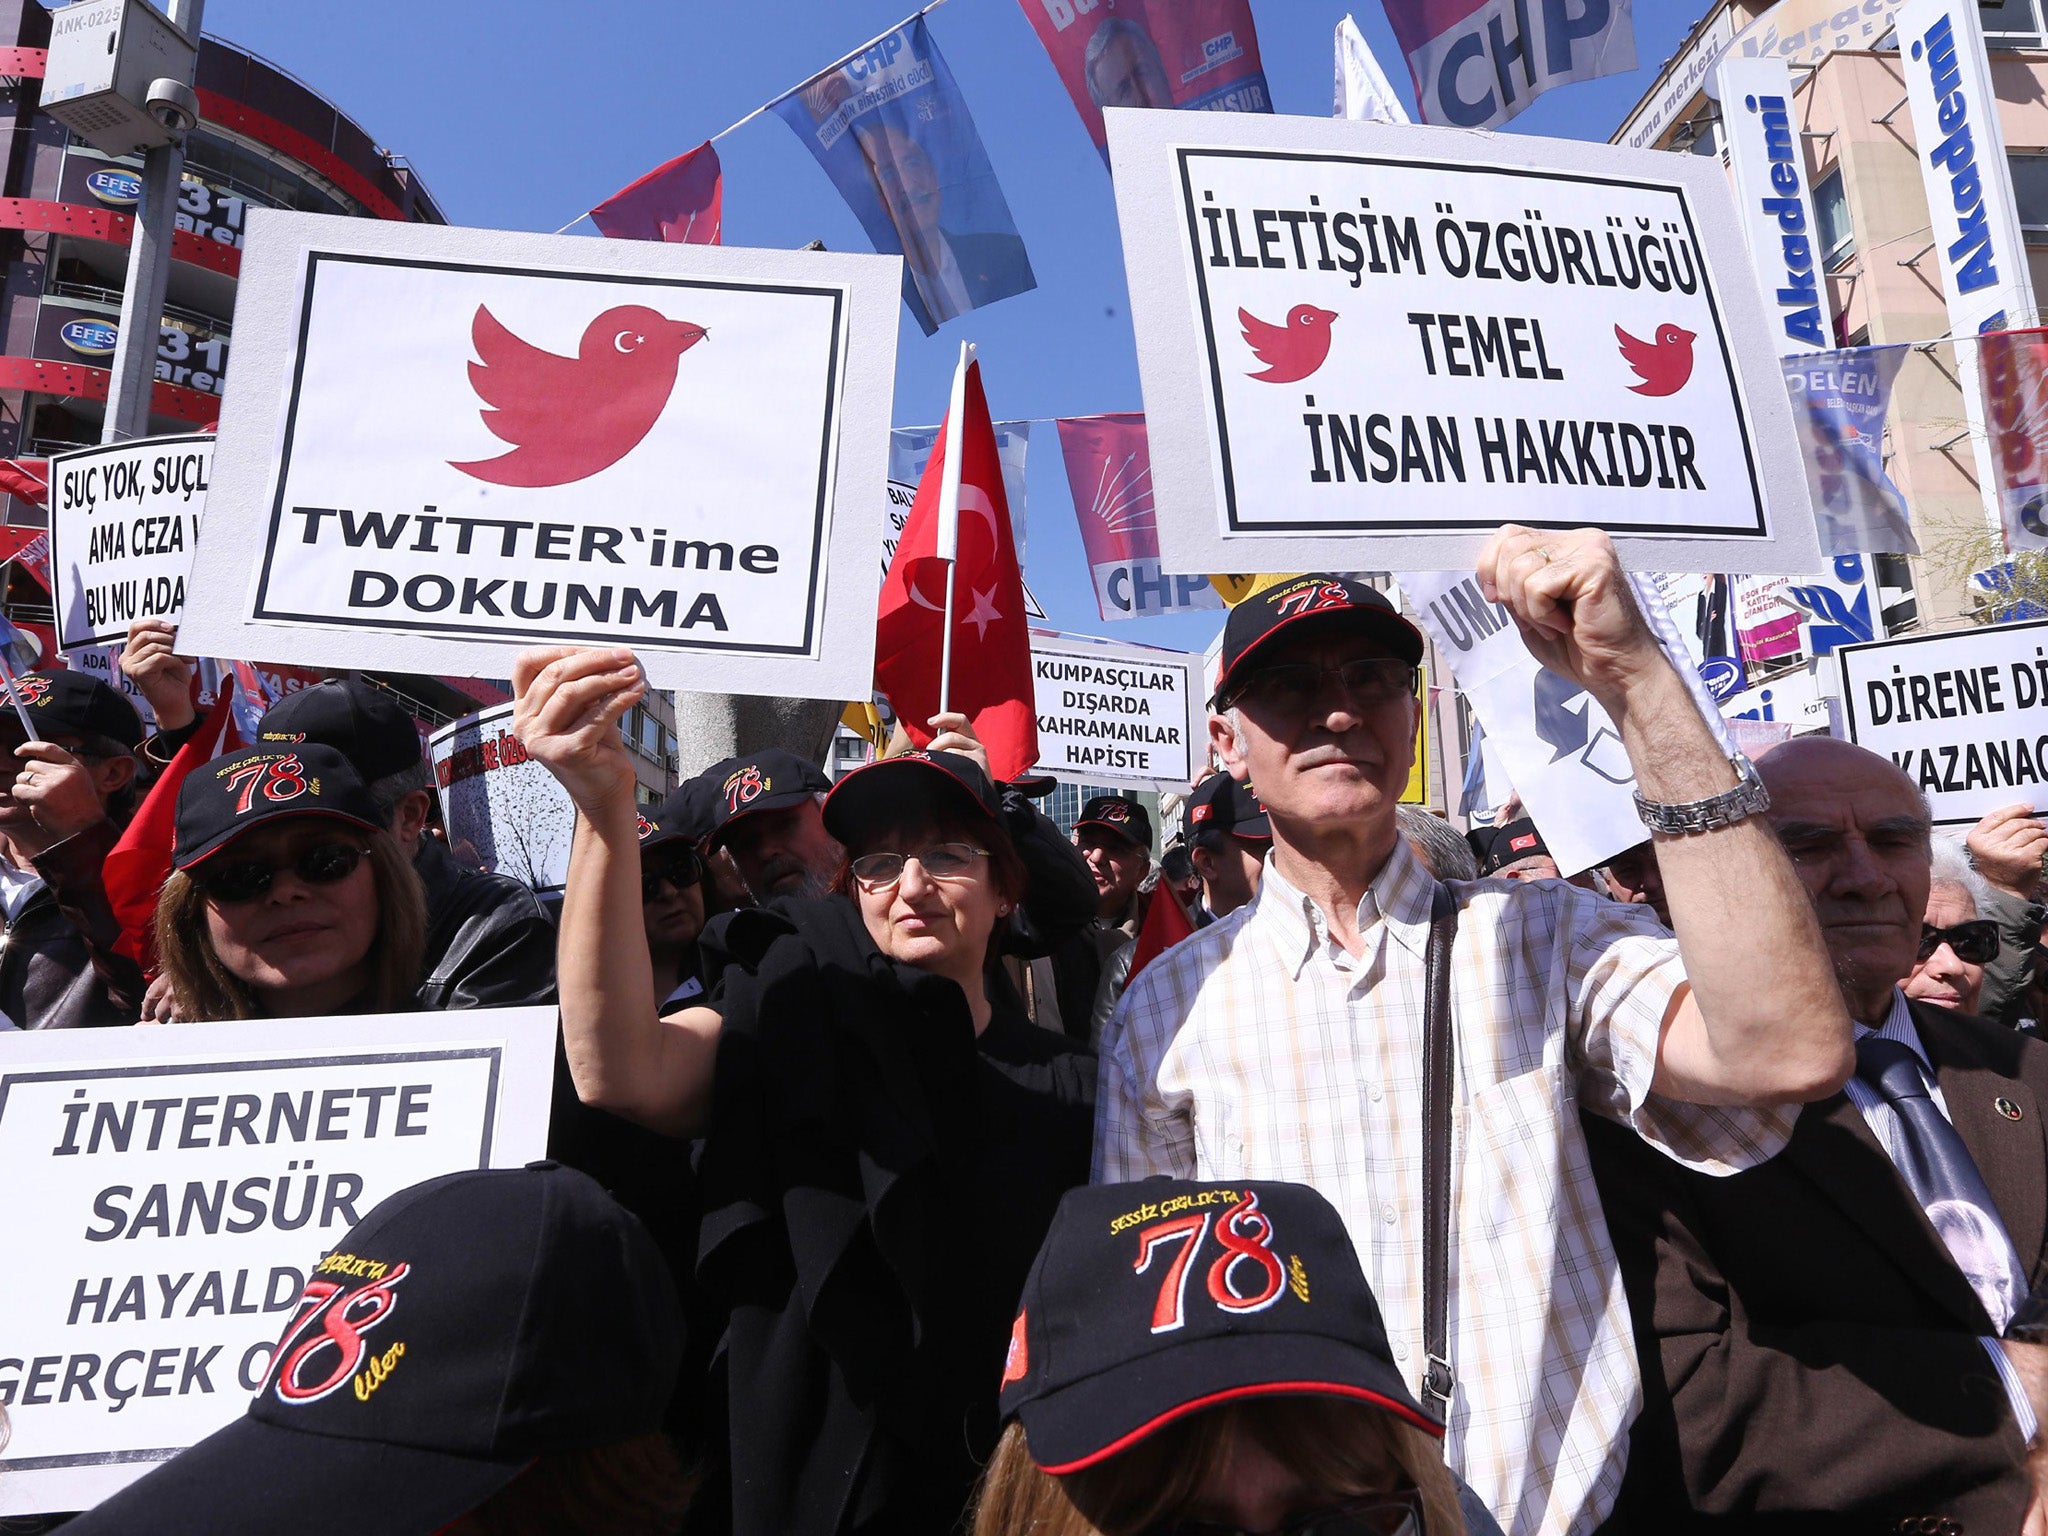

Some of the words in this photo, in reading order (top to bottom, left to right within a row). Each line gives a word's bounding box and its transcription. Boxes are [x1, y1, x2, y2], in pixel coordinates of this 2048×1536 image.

[55, 6, 121, 37] ANK-0225
[1206, 35, 1233, 56] CHP
[847, 30, 904, 81] CHP
[1438, 0, 1610, 127] CHP
[1664, 34, 1719, 115] merkezi
[1912, 12, 2000, 295] Akademi
[96, 173, 141, 194] EFES
[178, 180, 243, 229] 31
[1202, 190, 1422, 289] İLETİŞİM
[1434, 202, 1698, 296] ÖZGÜRLÜĞÜ
[1745, 94, 1827, 348] Akademi
[70, 324, 117, 345] EFES
[158, 326, 222, 372] 31
[1407, 312, 1564, 382] TEMEL
[1303, 395, 1466, 484] İNSAN
[1477, 417, 1707, 491] HAKKIDIR
[63, 466, 97, 514] SUÇ
[102, 459, 145, 504] YOK,
[152, 453, 213, 502] SUÇL
[88, 521, 125, 565] AMA
[131, 515, 184, 557] CEZA
[86, 586, 107, 628] BU
[111, 580, 136, 622] MU
[347, 569, 730, 632] DOKUNMA
[1107, 566, 1211, 611] CHP
[1277, 582, 1350, 615] 78
[83, 653, 110, 670] ADA
[1036, 660, 1175, 692] KUMPASÇILAR
[1062, 691, 1151, 716] DIŞARDA
[1867, 665, 2004, 726] DİRENE
[1035, 715, 1180, 745] KAHRAMANLAR
[1066, 743, 1149, 769] HAPİSTE
[225, 753, 307, 815] 78
[725, 765, 763, 814] 78
[1097, 802, 1128, 822] 78
[51, 1084, 432, 1156] İNTERNETE
[85, 1160, 364, 1243] SANSÜR
[1110, 1203, 1158, 1236] SESSİZ
[1133, 1189, 1287, 1334] 78
[255, 1262, 411, 1404] 78
